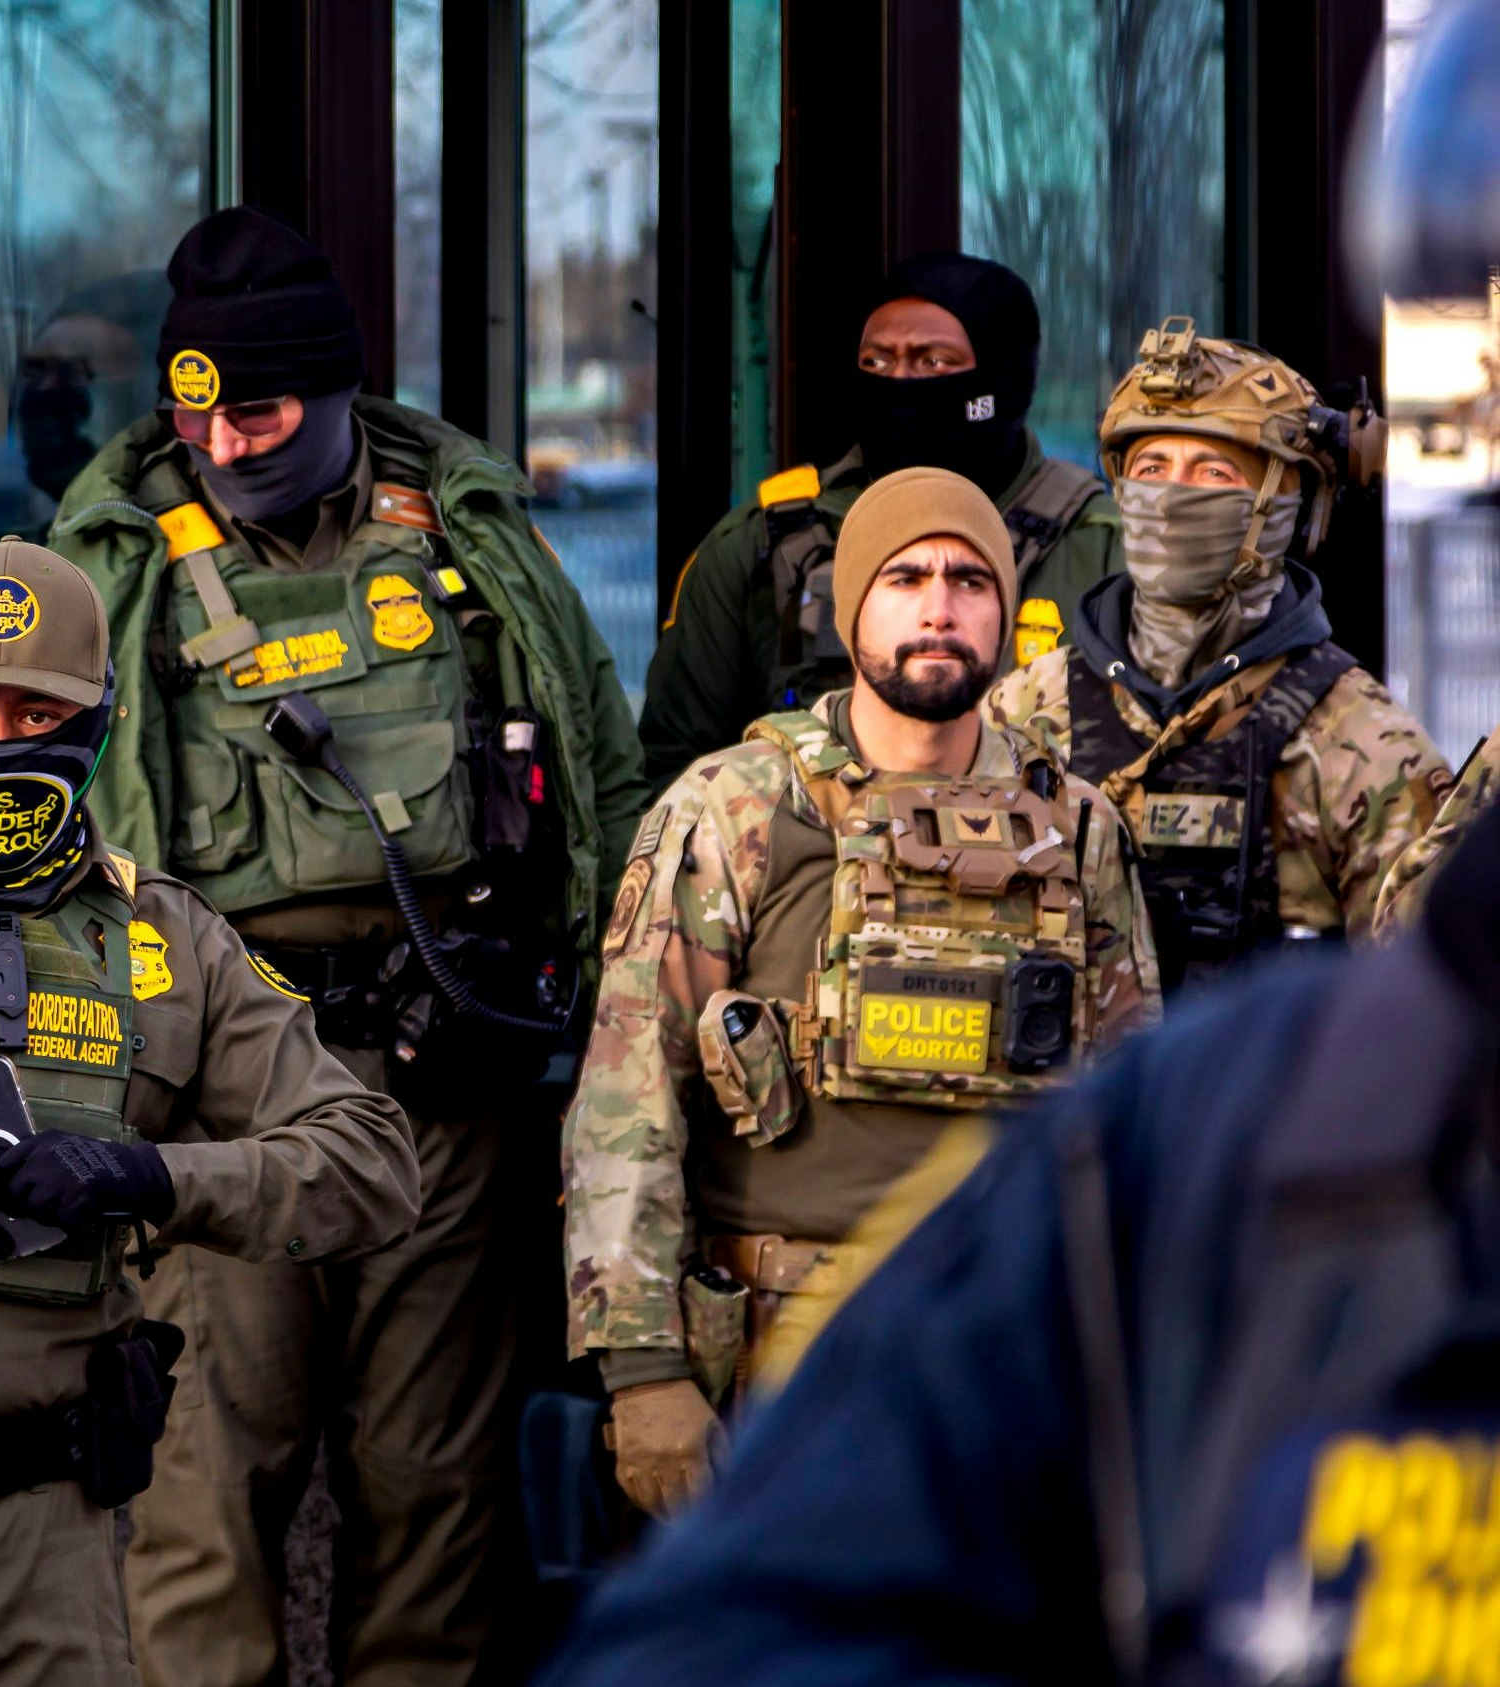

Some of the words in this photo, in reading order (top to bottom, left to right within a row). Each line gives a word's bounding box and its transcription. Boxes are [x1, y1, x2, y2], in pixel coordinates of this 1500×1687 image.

[285, 629, 349, 662] PATROL
[27, 992, 78, 1035] BORDER
[78, 998, 123, 1042] PATROL
[866, 1001, 986, 1037] POLICE
[27, 1034, 78, 1061] FEDERAL
[78, 1041, 119, 1067] AGENT
[896, 1039, 981, 1062] BORTAC
